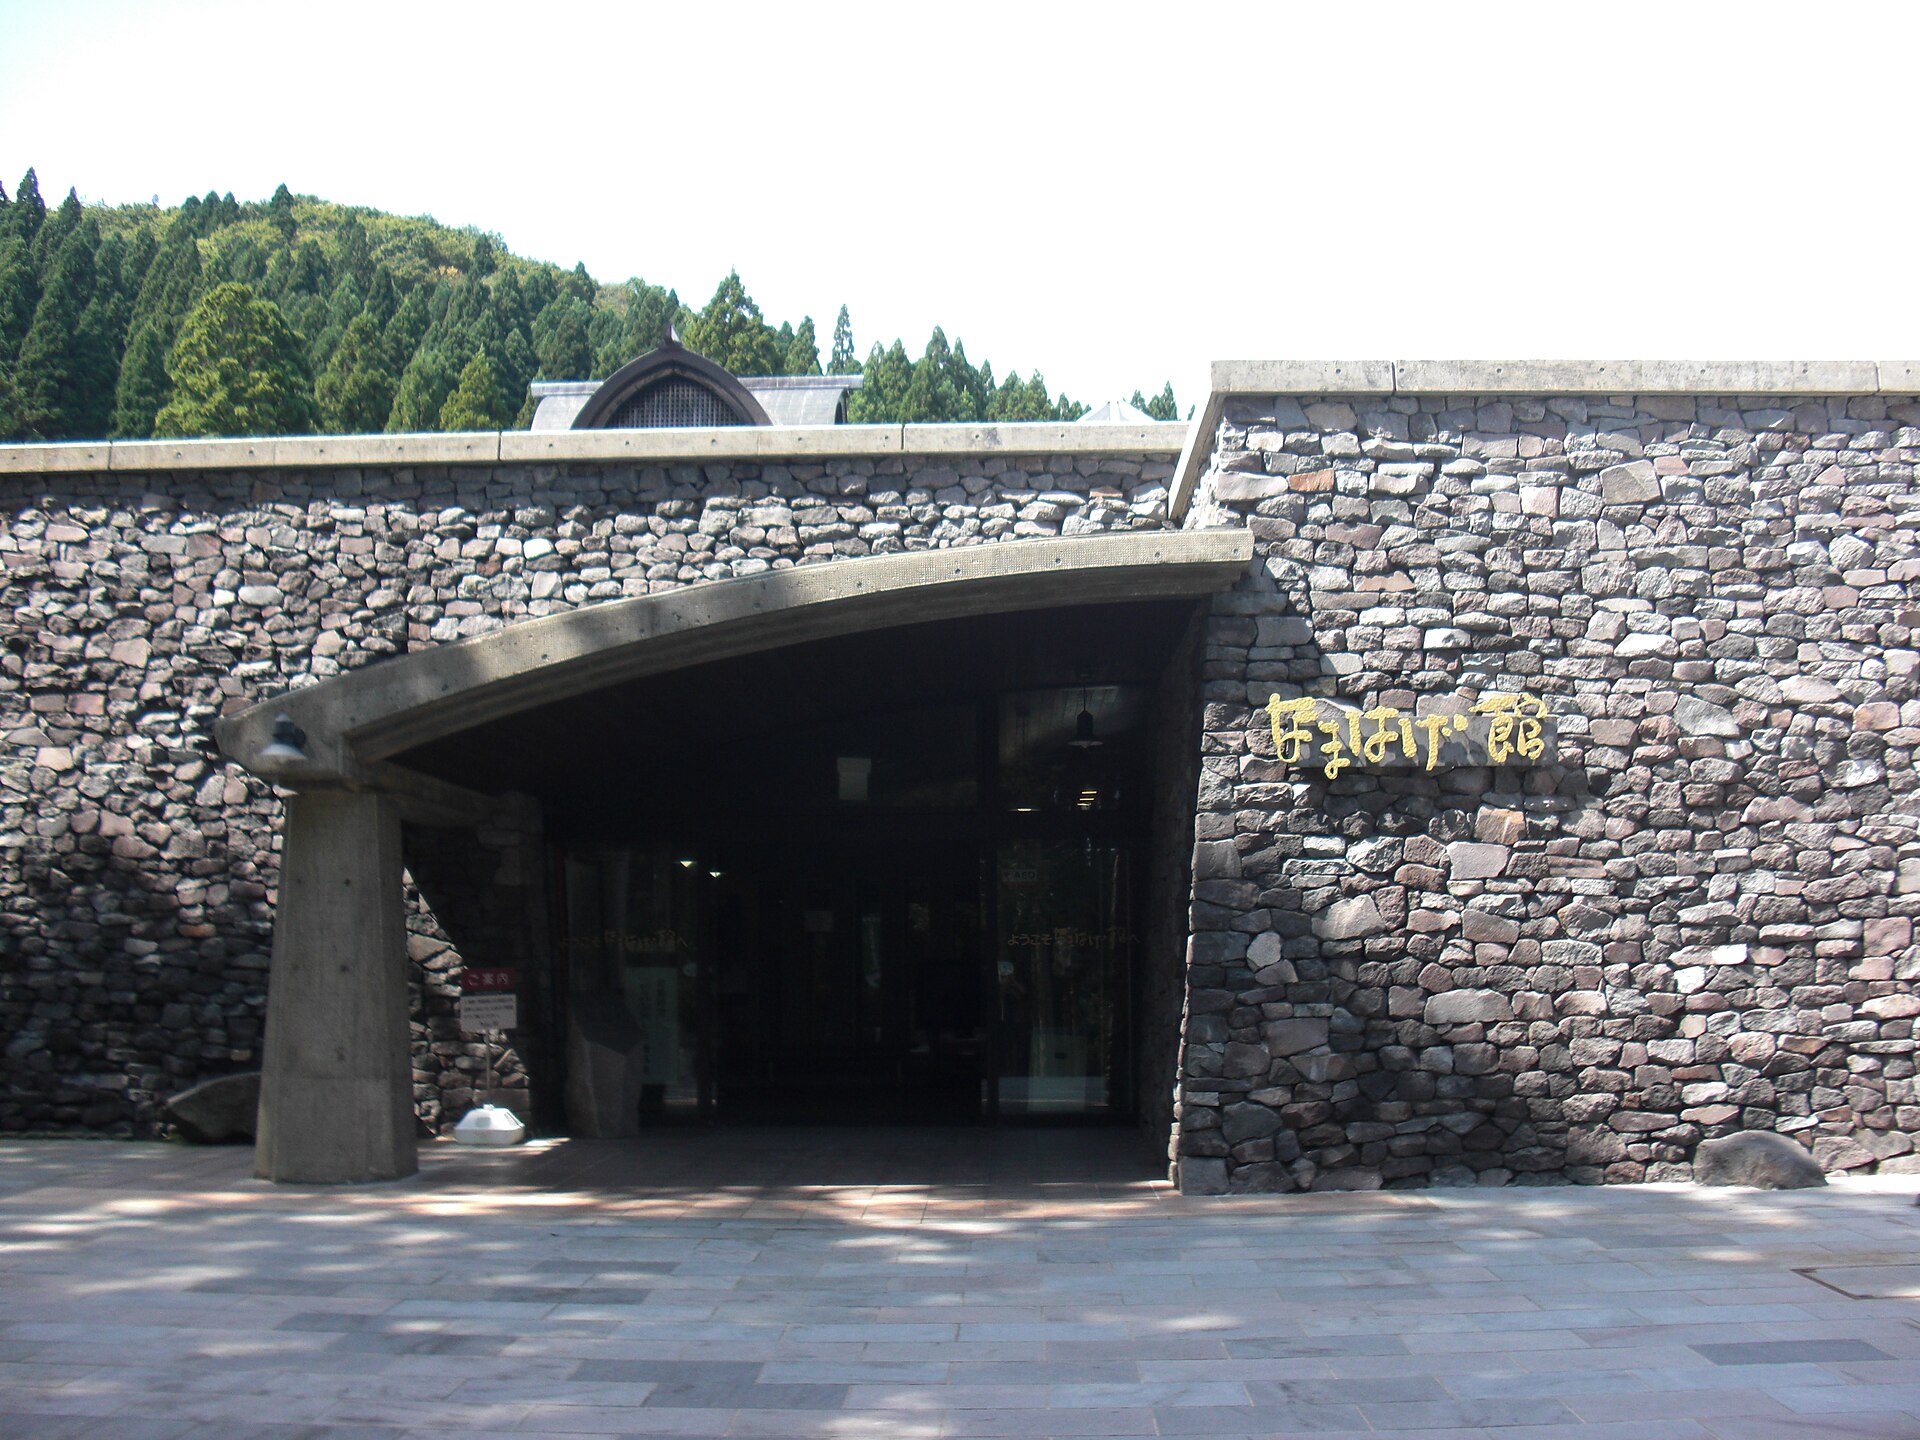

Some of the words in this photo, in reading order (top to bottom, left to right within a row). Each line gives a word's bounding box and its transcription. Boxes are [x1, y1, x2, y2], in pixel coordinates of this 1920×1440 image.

[1265, 692, 1548, 780] なまはげ館
[468, 972, 509, 986] ご案内
